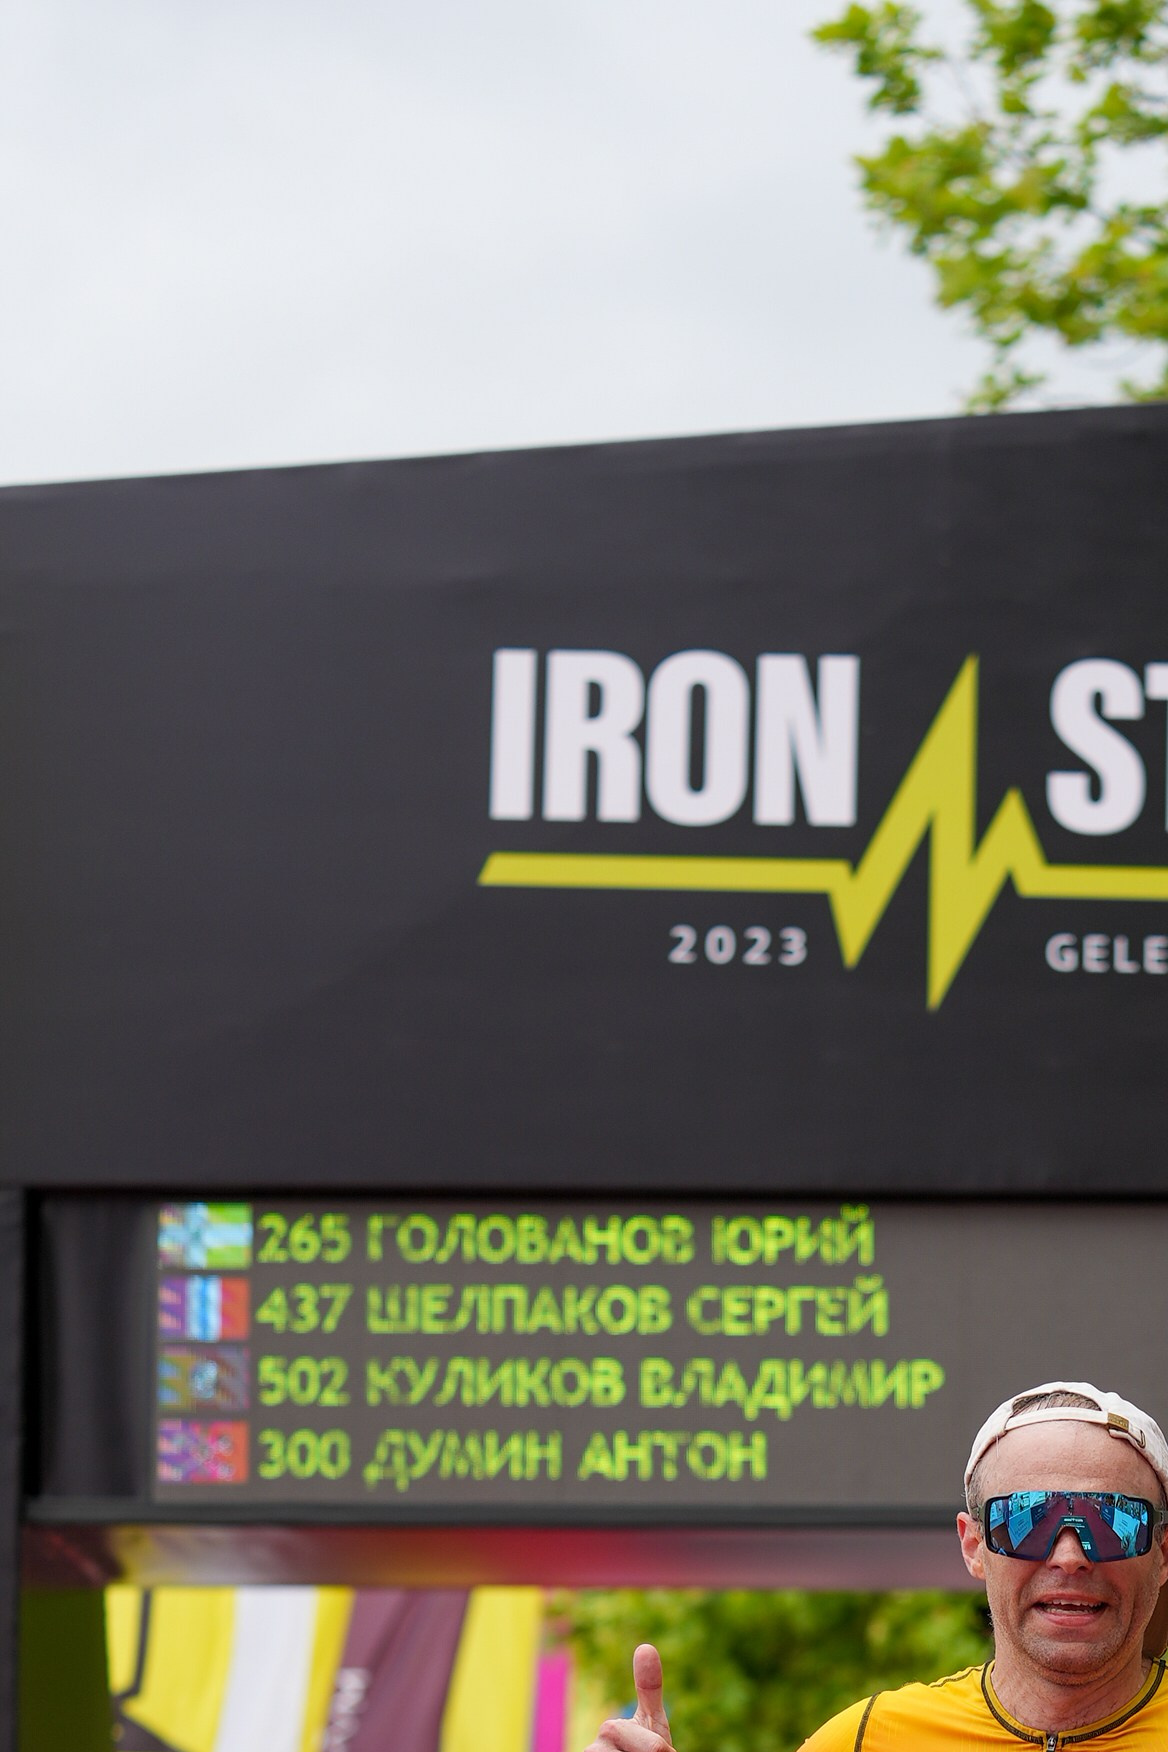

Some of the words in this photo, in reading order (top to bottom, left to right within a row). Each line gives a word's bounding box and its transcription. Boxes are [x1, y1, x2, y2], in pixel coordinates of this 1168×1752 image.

[490, 648, 860, 828] IRON
[668, 924, 808, 967] 2023
[257, 1212, 352, 1265] 265
[366, 1212, 695, 1266] ГОЛОВАНОВ
[711, 1204, 876, 1266] ЮРИЙ
[255, 1283, 352, 1334] 437
[367, 1283, 674, 1336] ШЕЛПАКОВ
[685, 1275, 890, 1337] СЕРГЕЙ
[258, 1355, 349, 1407] 502
[366, 1356, 627, 1407] КУЛИКОВ
[639, 1356, 946, 1421] ВЛАДИМИР
[258, 1428, 351, 1480] 300
[362, 1428, 563, 1492] ДУМИН
[577, 1429, 769, 1481] АНТОН
